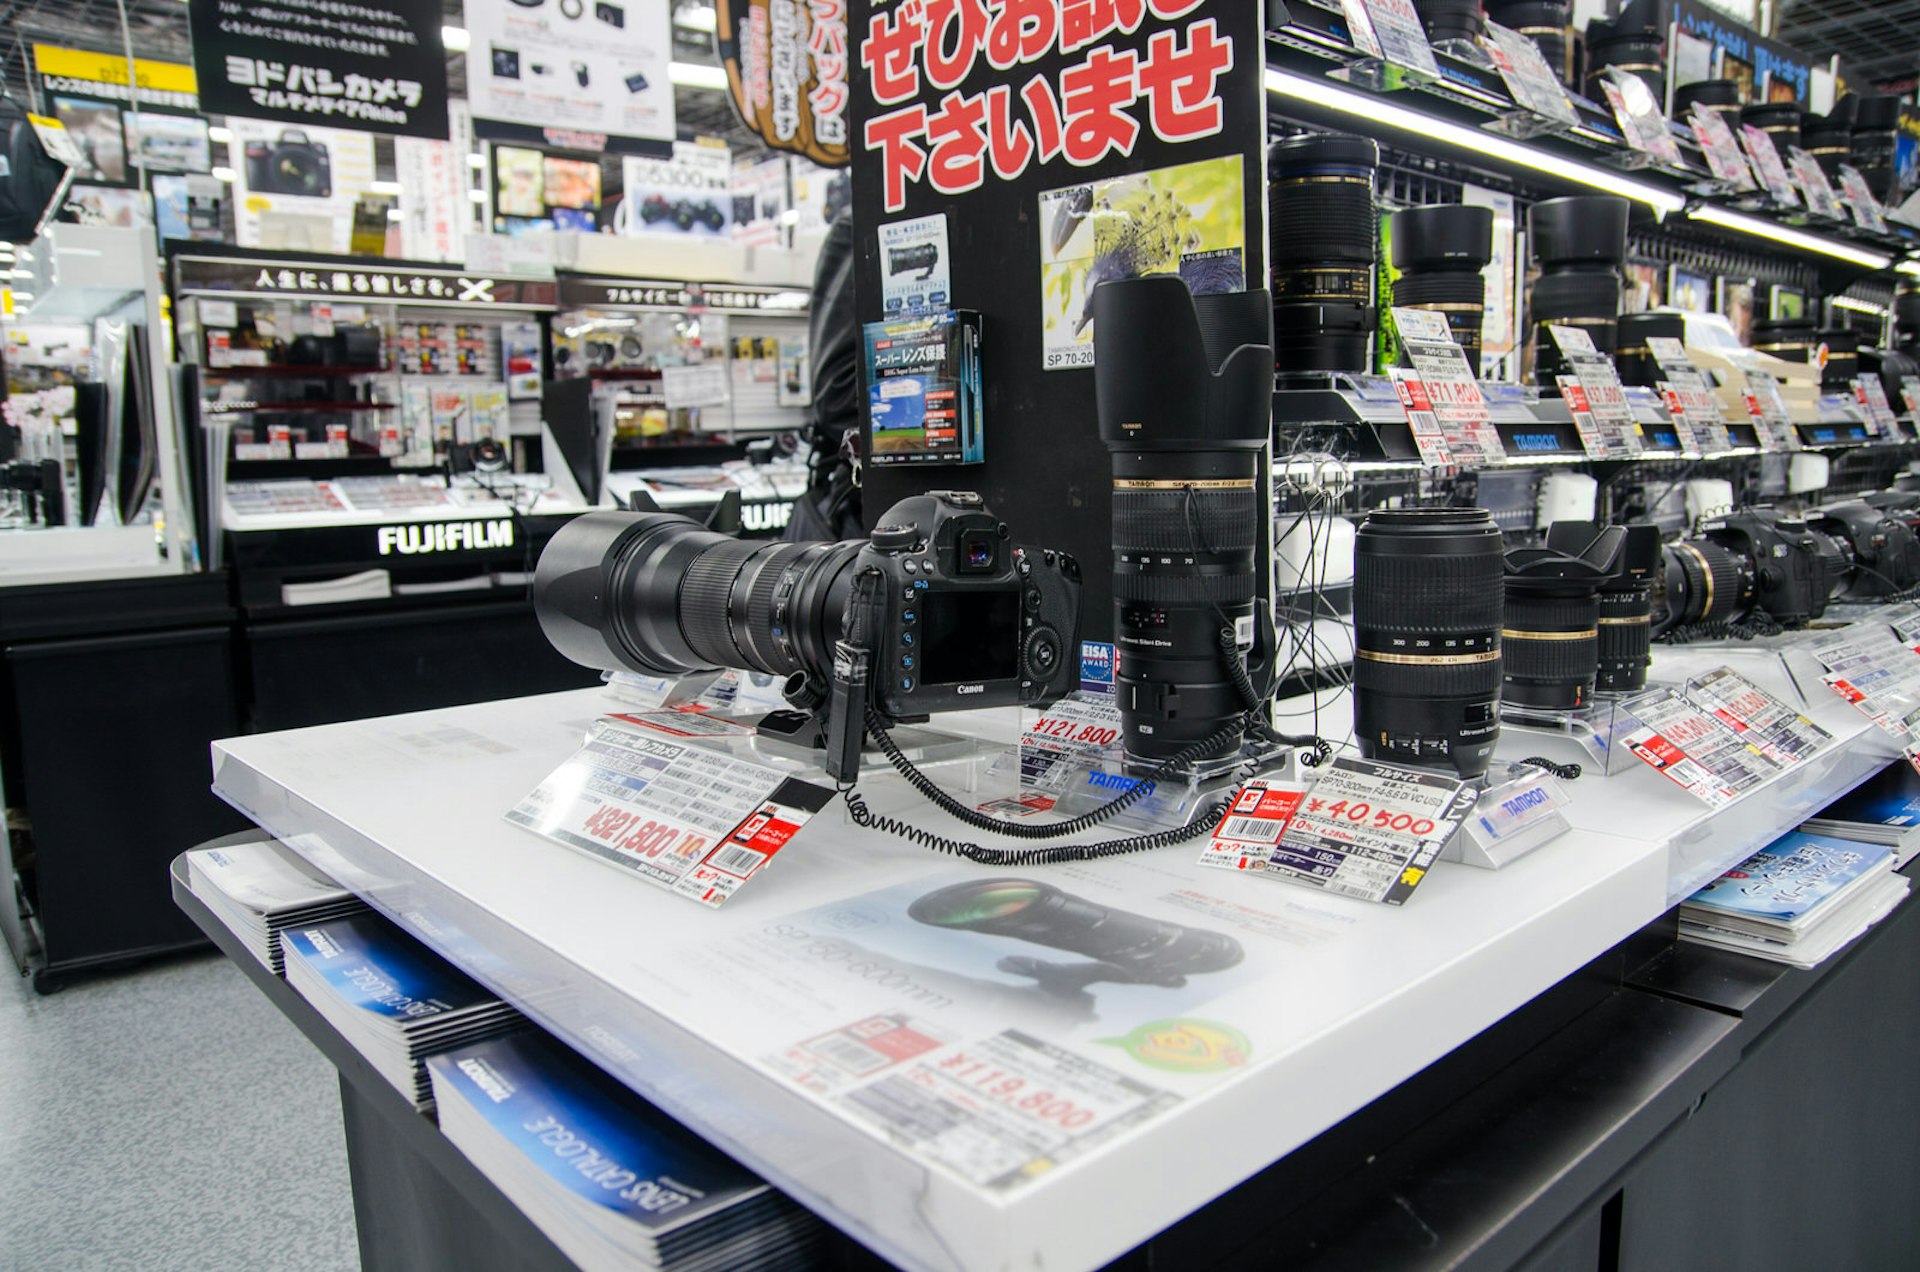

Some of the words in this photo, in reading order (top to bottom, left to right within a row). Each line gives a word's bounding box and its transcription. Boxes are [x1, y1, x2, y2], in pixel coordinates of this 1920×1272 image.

[226, 55, 423, 107] ヨドバシカメラ
[865, 17, 1234, 213] 下さいませ
[1048, 354, 1062, 366] SP
[1513, 435, 1561, 450] TAMRON
[378, 519, 514, 555] FUJIFILM
[1082, 645, 1109, 659] EISA
[1082, 659, 1109, 668] AWARD
[957, 684, 984, 695] Canon
[1032, 718, 1117, 745] ¥121,800
[1329, 769, 1355, 779] タムロン
[1373, 768, 1423, 783] フルサイズ
[1261, 798, 1298, 806] バーコード
[1373, 787, 1399, 800] F4-5.6
[1411, 793, 1425, 803] VC
[1425, 796, 1443, 808] USD
[1501, 787, 1550, 817] TAMRON
[583, 804, 680, 857] ¥321,800
[1312, 865, 1334, 877] あり
[457, 1058, 511, 1104] TAMRON
[939, 1053, 1096, 1130] ¥119,800
